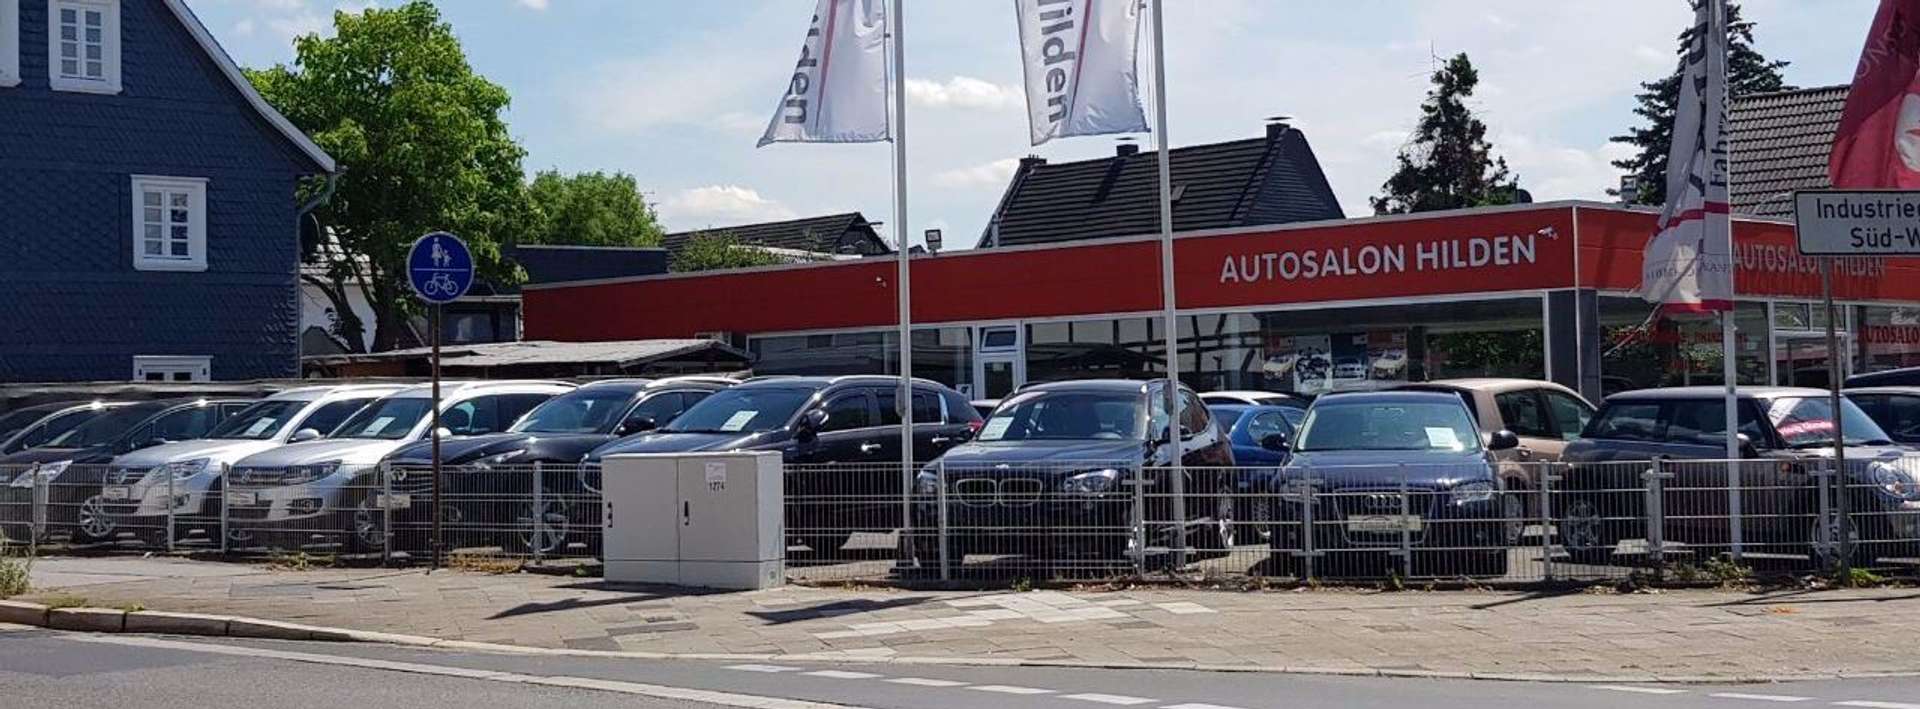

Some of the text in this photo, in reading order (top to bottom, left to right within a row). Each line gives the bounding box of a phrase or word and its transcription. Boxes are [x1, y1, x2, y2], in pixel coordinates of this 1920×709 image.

[1816, 197, 1920, 223] Industrie
[1220, 234, 1537, 283] AUTOSALON HILDEN
